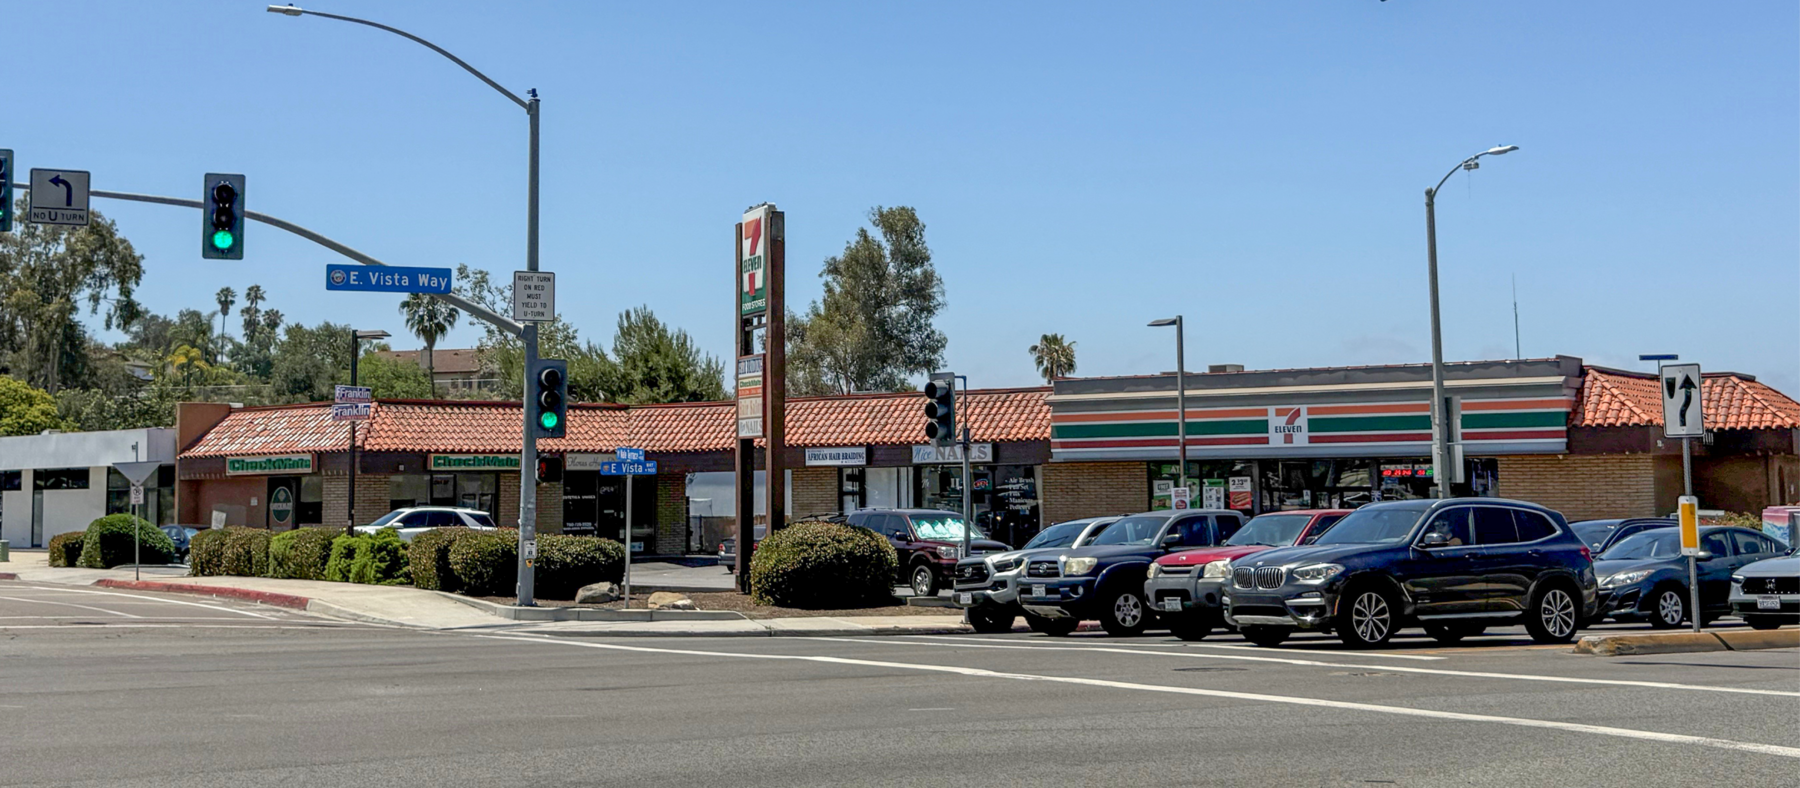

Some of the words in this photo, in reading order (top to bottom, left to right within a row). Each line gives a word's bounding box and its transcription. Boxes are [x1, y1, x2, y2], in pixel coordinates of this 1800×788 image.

[34, 211, 46, 220] NO
[49, 210, 58, 221] U
[61, 212, 84, 221] TURN
[350, 271, 363, 285] E.
[369, 271, 409, 286] Vista
[418, 273, 448, 290] Way
[341, 387, 371, 398] Franklin
[333, 404, 370, 417] Franklin
[842, 452, 864, 460] BRAIDING
[914, 447, 932, 461] Nice
[611, 464, 616, 473] E
[622, 463, 643, 473] Vista
